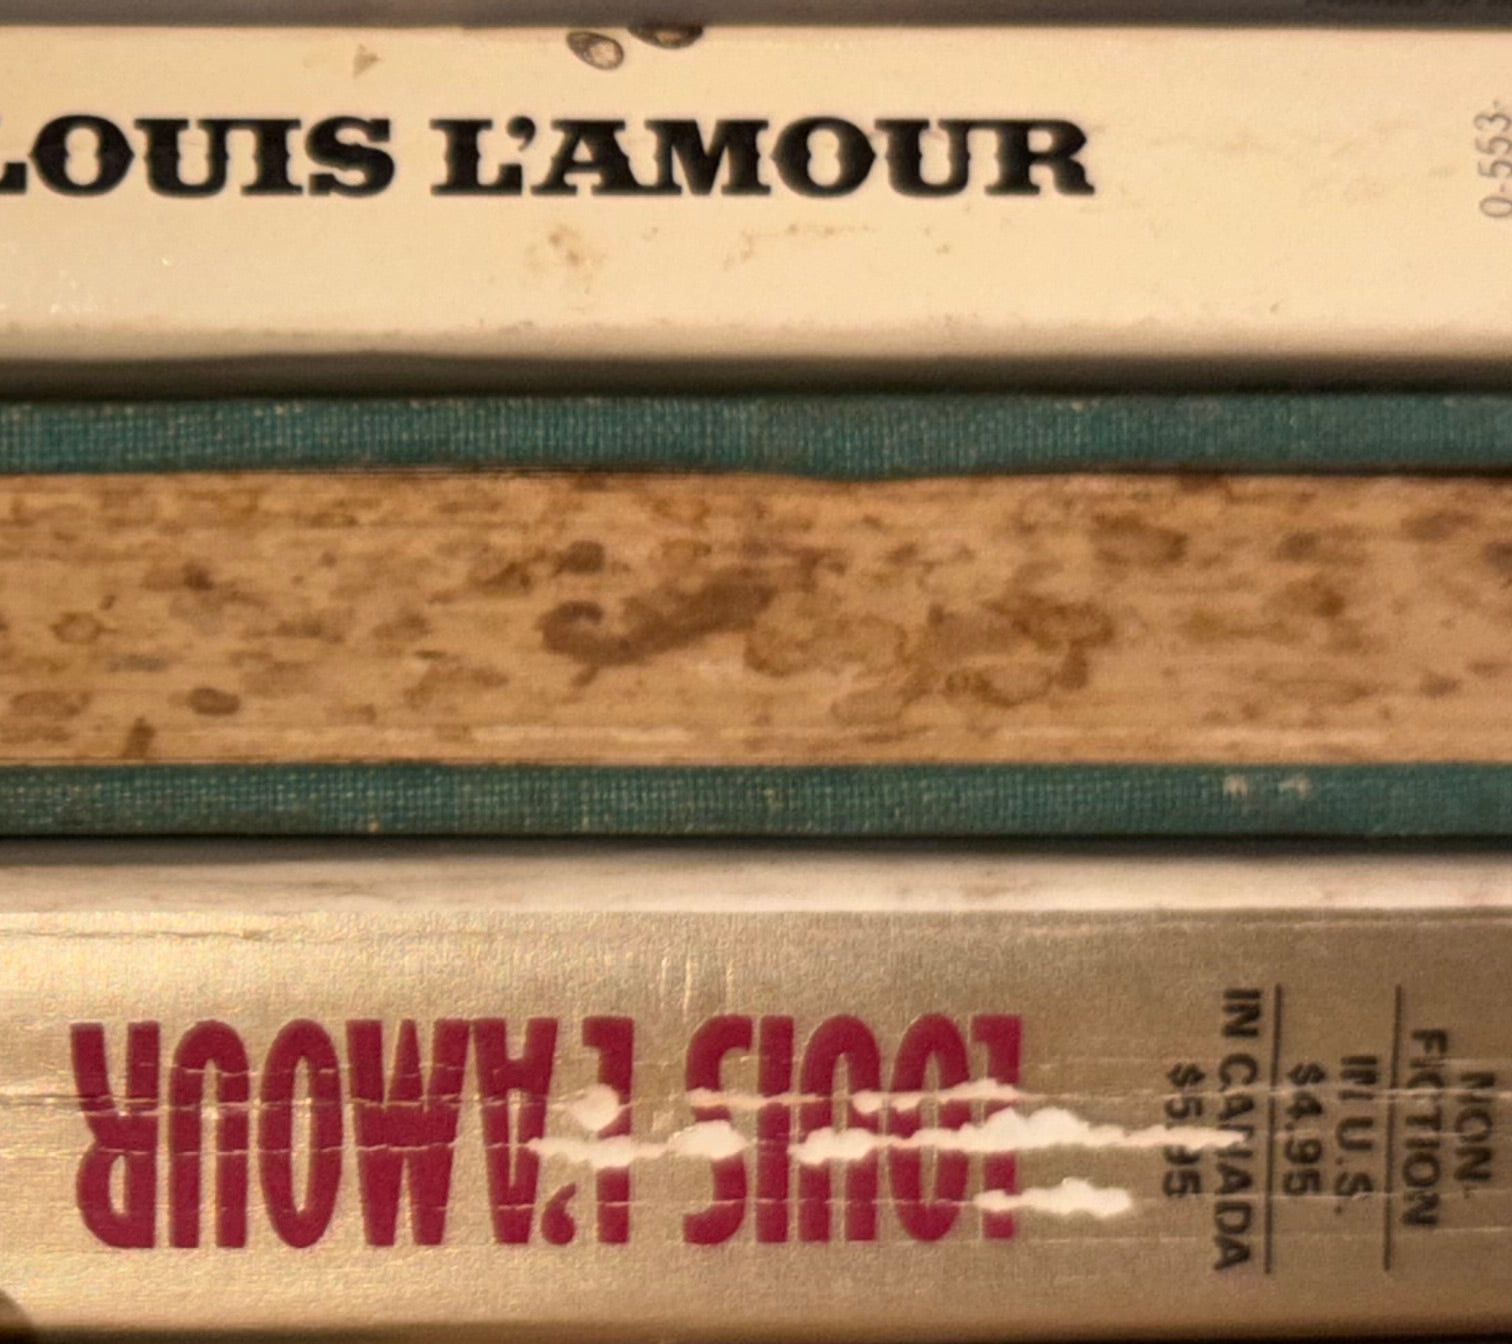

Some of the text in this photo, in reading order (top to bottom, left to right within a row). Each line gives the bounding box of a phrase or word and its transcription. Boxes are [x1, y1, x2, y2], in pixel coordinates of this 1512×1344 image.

[429, 115, 1095, 197] L'AMOUR
[70, 1016, 635, 1249] L'AMOUR
[682, 1013, 1022, 1246] LOUIS
[1214, 987, 1262, 1271] IN CANADA
[1283, 1063, 1326, 1197] $4.95
[1334, 1116, 1375, 1216] U.S.
[1402, 1029, 1447, 1228] FICTION
